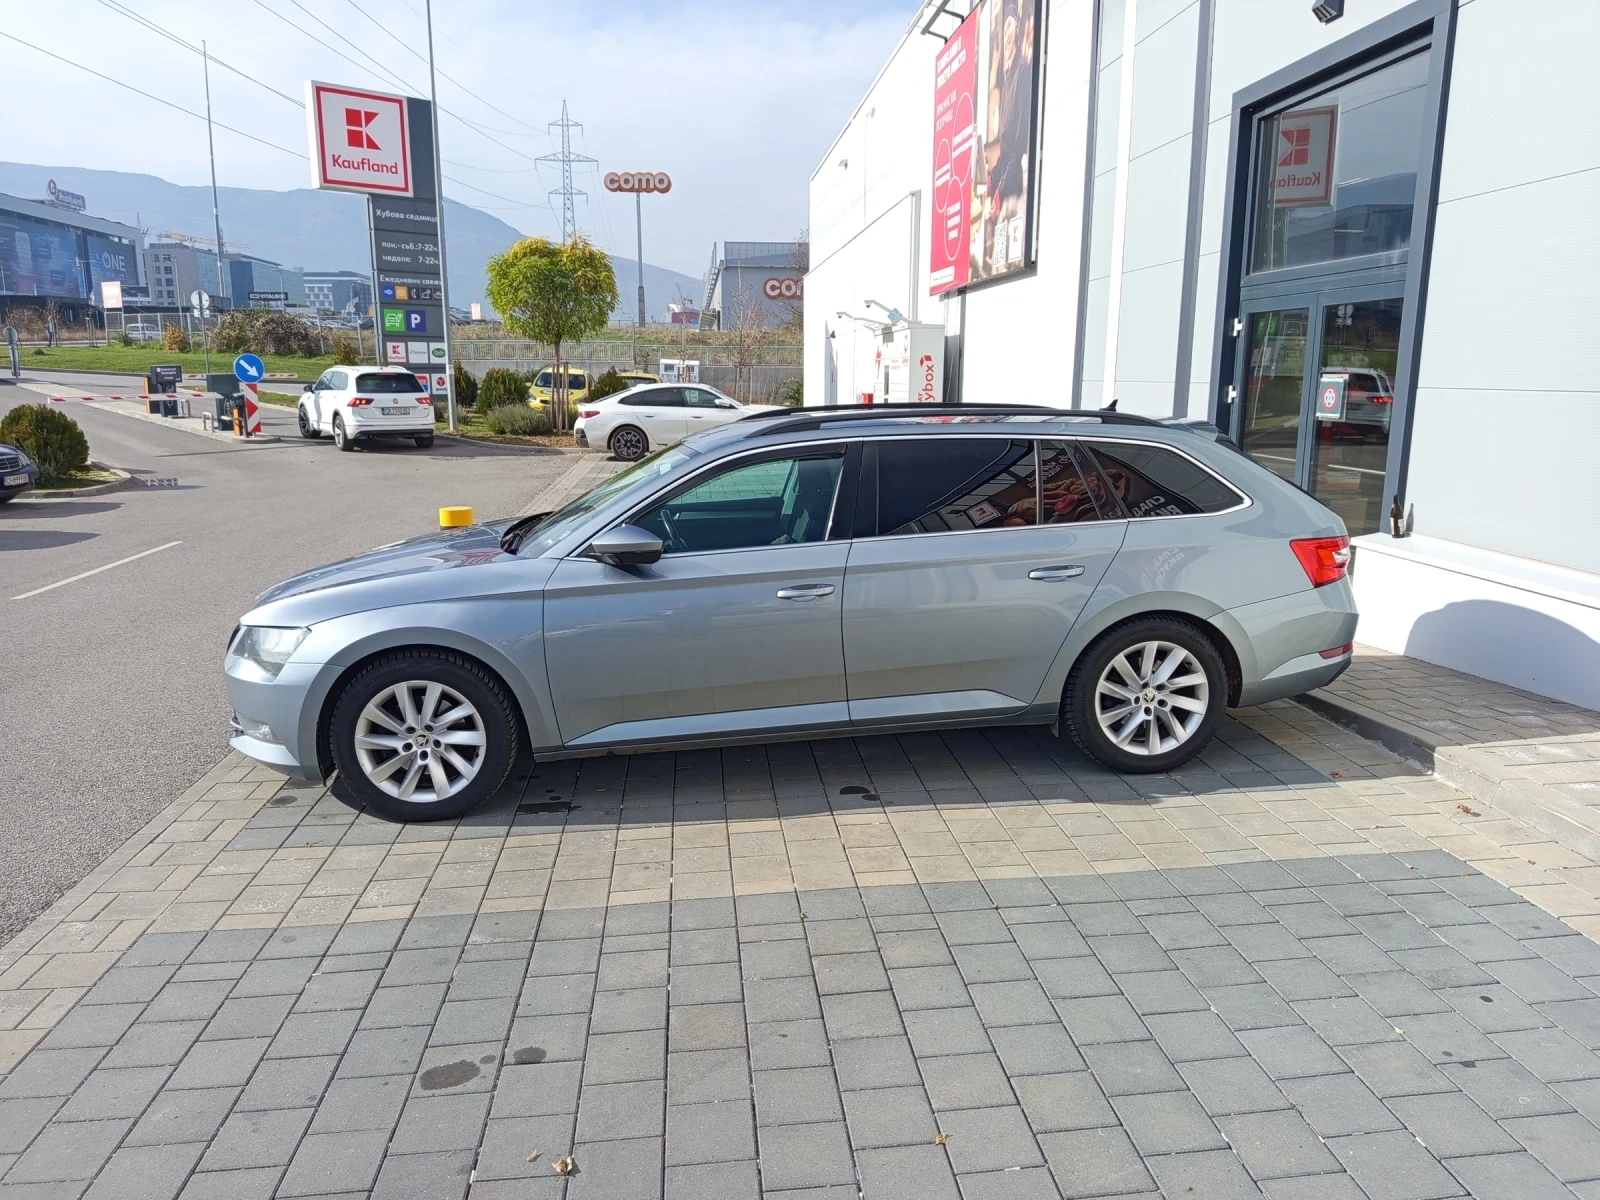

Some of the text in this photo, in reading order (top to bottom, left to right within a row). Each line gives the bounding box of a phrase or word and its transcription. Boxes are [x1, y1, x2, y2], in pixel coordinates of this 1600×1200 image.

[332, 153, 398, 175] Kaufland
[604, 172, 670, 190] como
[376, 208, 405, 219] Хубава
[102, 251, 126, 272] ONE
[382, 255, 412, 263] неделя:
[380, 274, 420, 284] Ежедневно
[410, 313, 421, 328] P
